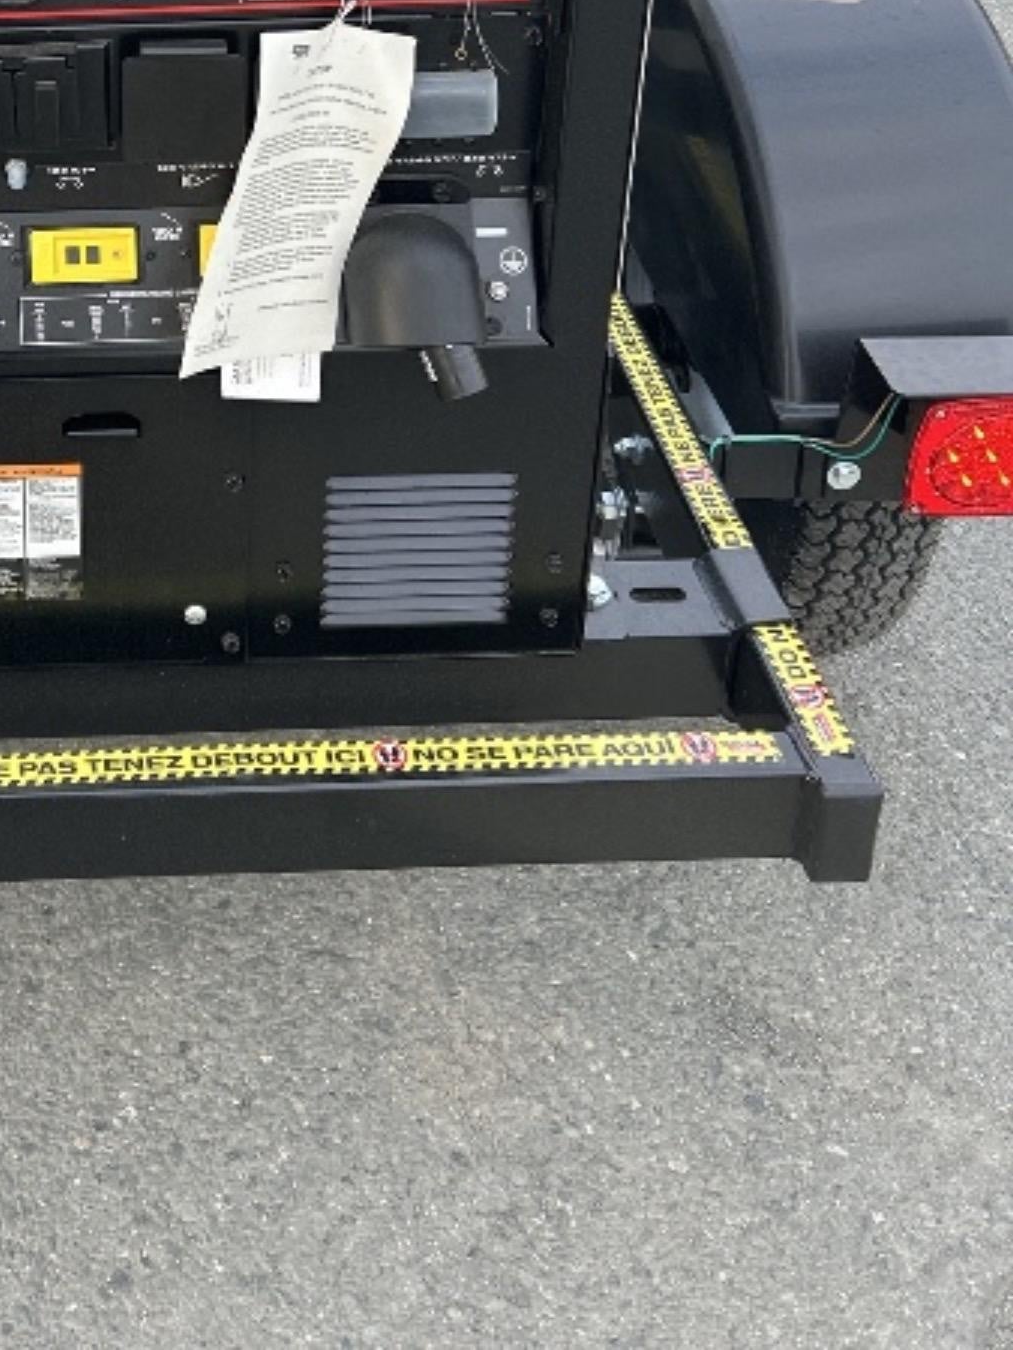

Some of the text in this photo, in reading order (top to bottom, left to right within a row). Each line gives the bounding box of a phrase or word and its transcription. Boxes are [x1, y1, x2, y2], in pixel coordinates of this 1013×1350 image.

[19, 759, 77, 777] PAS
[84, 755, 184, 773] TENEZ
[191, 750, 317, 768] DEBOUT
[326, 748, 366, 763] ICI
[413, 746, 458, 762] NO
[466, 746, 506, 760] SE
[513, 743, 590, 759] PARE
